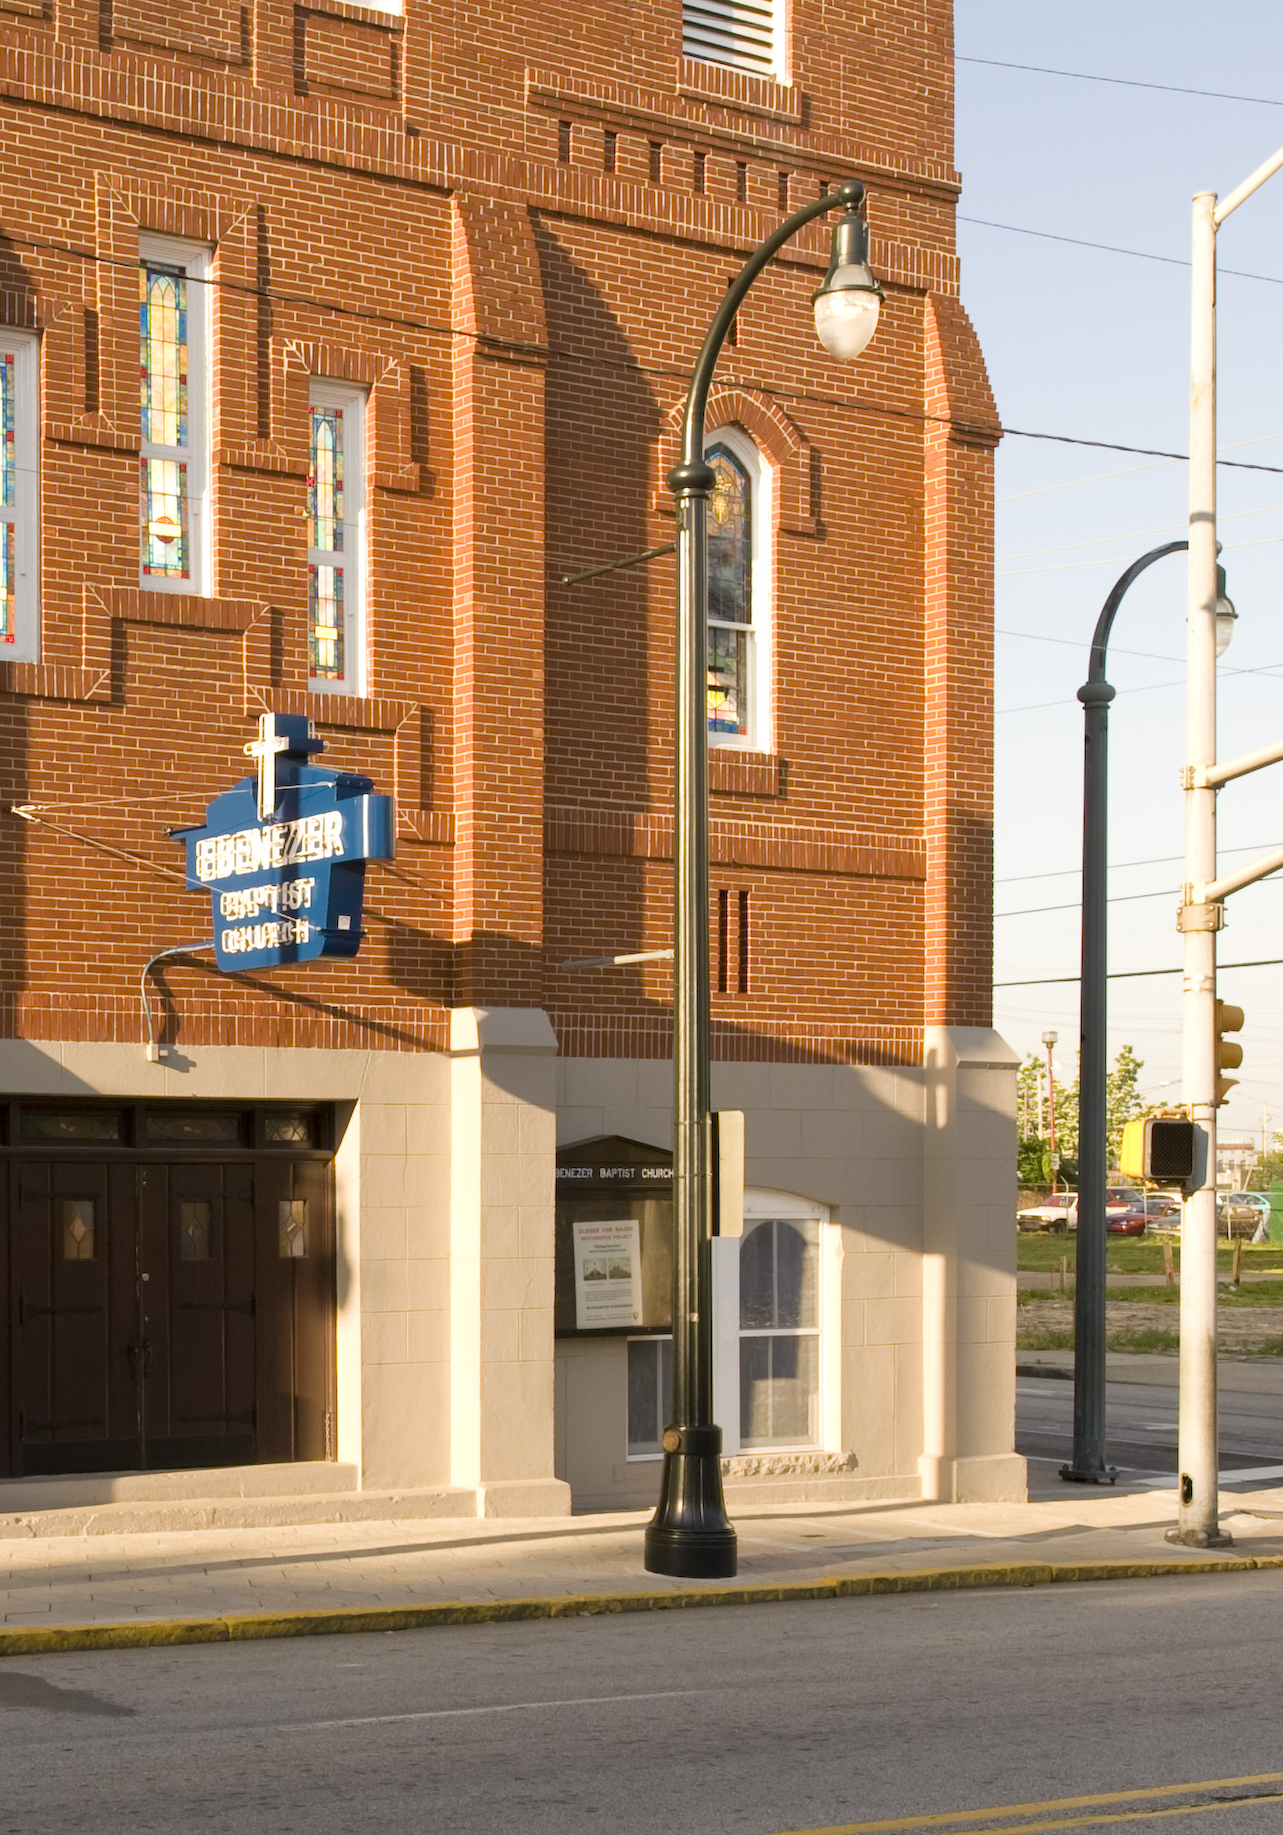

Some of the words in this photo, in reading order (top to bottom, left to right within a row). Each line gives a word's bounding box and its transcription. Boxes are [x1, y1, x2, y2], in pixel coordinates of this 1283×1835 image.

[195, 810, 344, 882] EBENEZER
[220, 877, 315, 921] BAPTIST
[221, 920, 310, 954] CHURCH
[556, 1168, 593, 1178] BENEZER
[599, 1168, 635, 1178] BAPTIST
[642, 1168, 674, 1178] CHURCH
